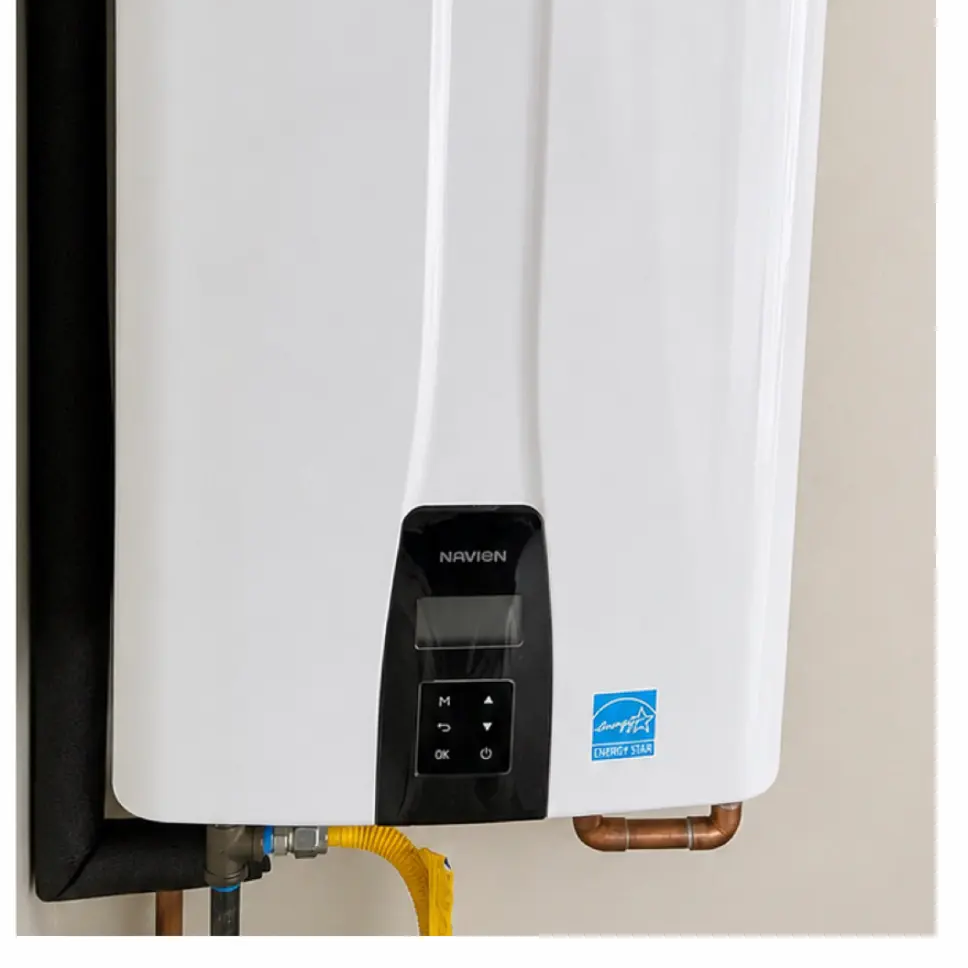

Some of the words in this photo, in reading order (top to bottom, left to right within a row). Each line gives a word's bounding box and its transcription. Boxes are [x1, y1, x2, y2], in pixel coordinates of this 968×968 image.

[439, 550, 507, 563] NAVIEN
[438, 695, 451, 707] M
[434, 749, 450, 760] OK
[594, 745, 629, 759] ENERGY
[630, 743, 653, 756] STAR
